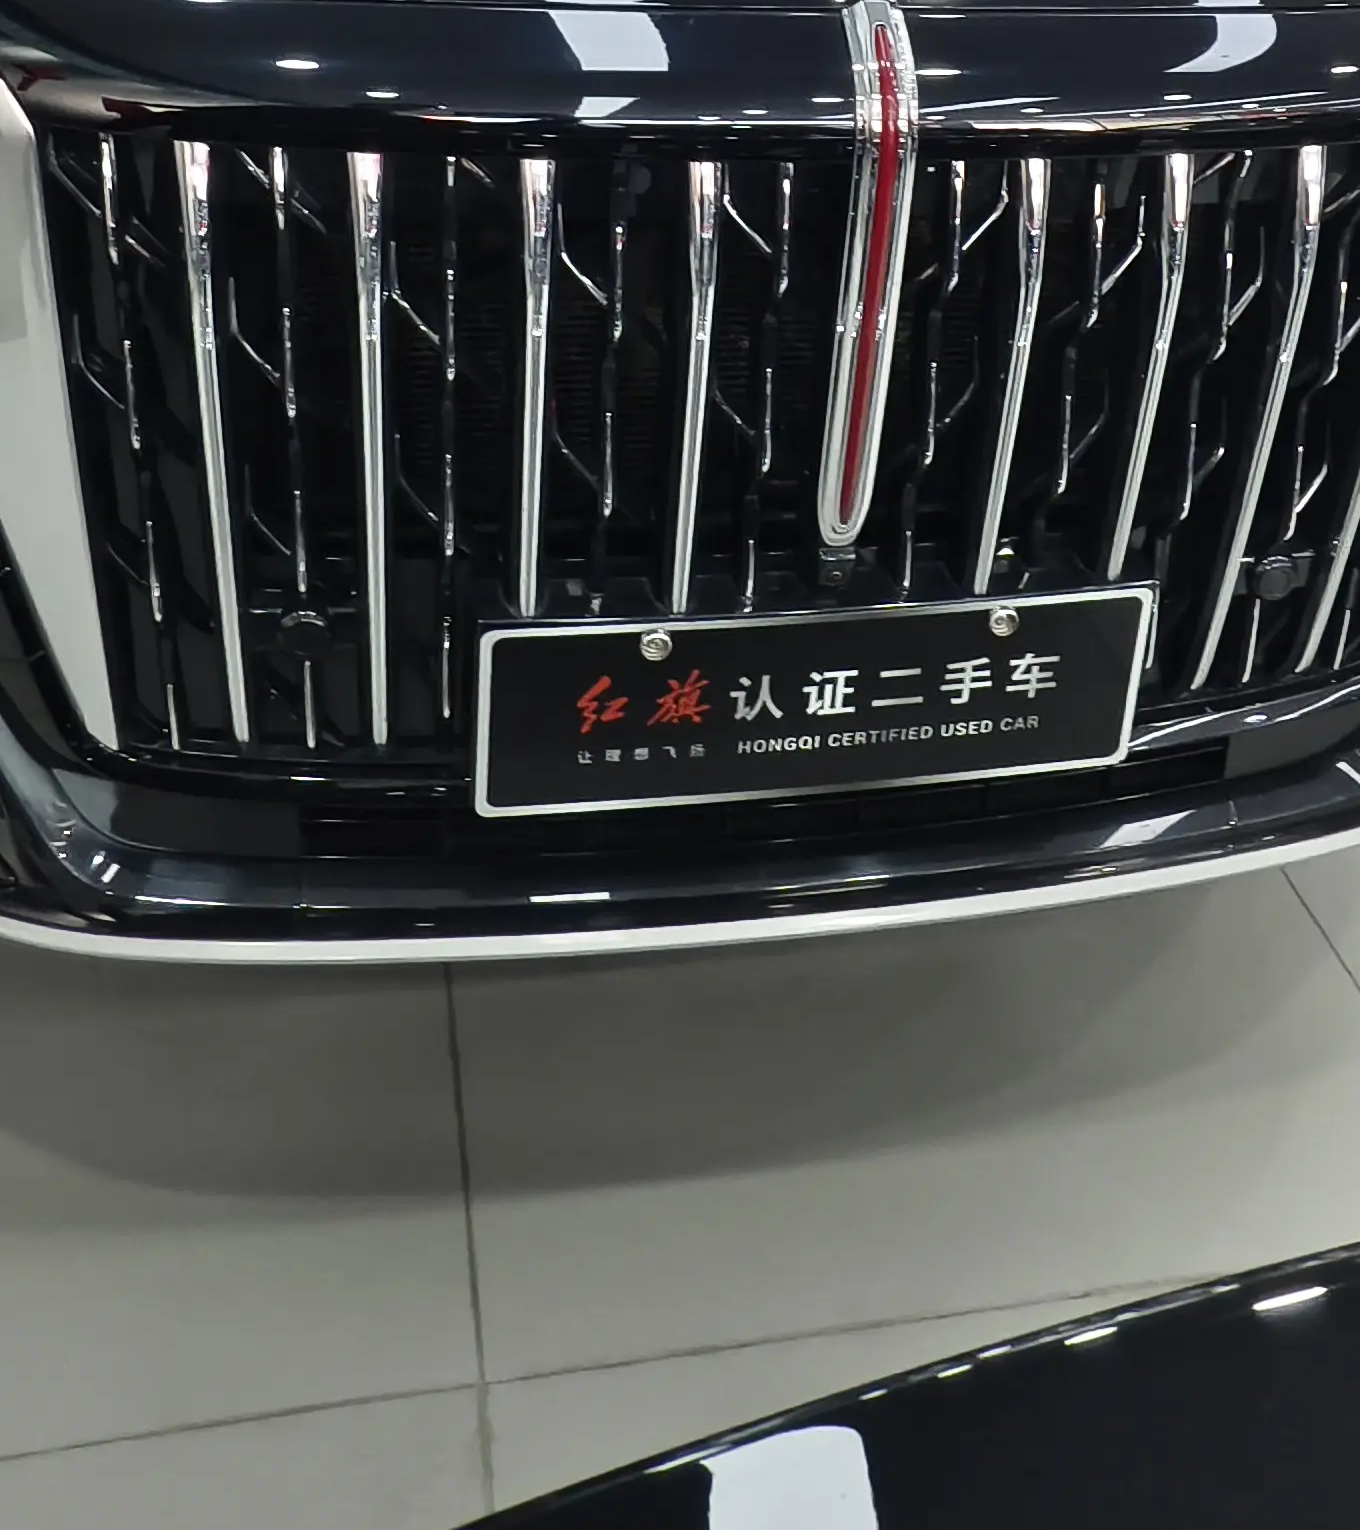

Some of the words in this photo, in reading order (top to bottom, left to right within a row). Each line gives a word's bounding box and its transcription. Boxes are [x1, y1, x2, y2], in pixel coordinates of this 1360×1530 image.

[737, 734, 821, 755] HONGQI
[827, 725, 934, 748] CERTIFIED
[940, 718, 993, 738] USED
[999, 715, 1040, 732] CAR
